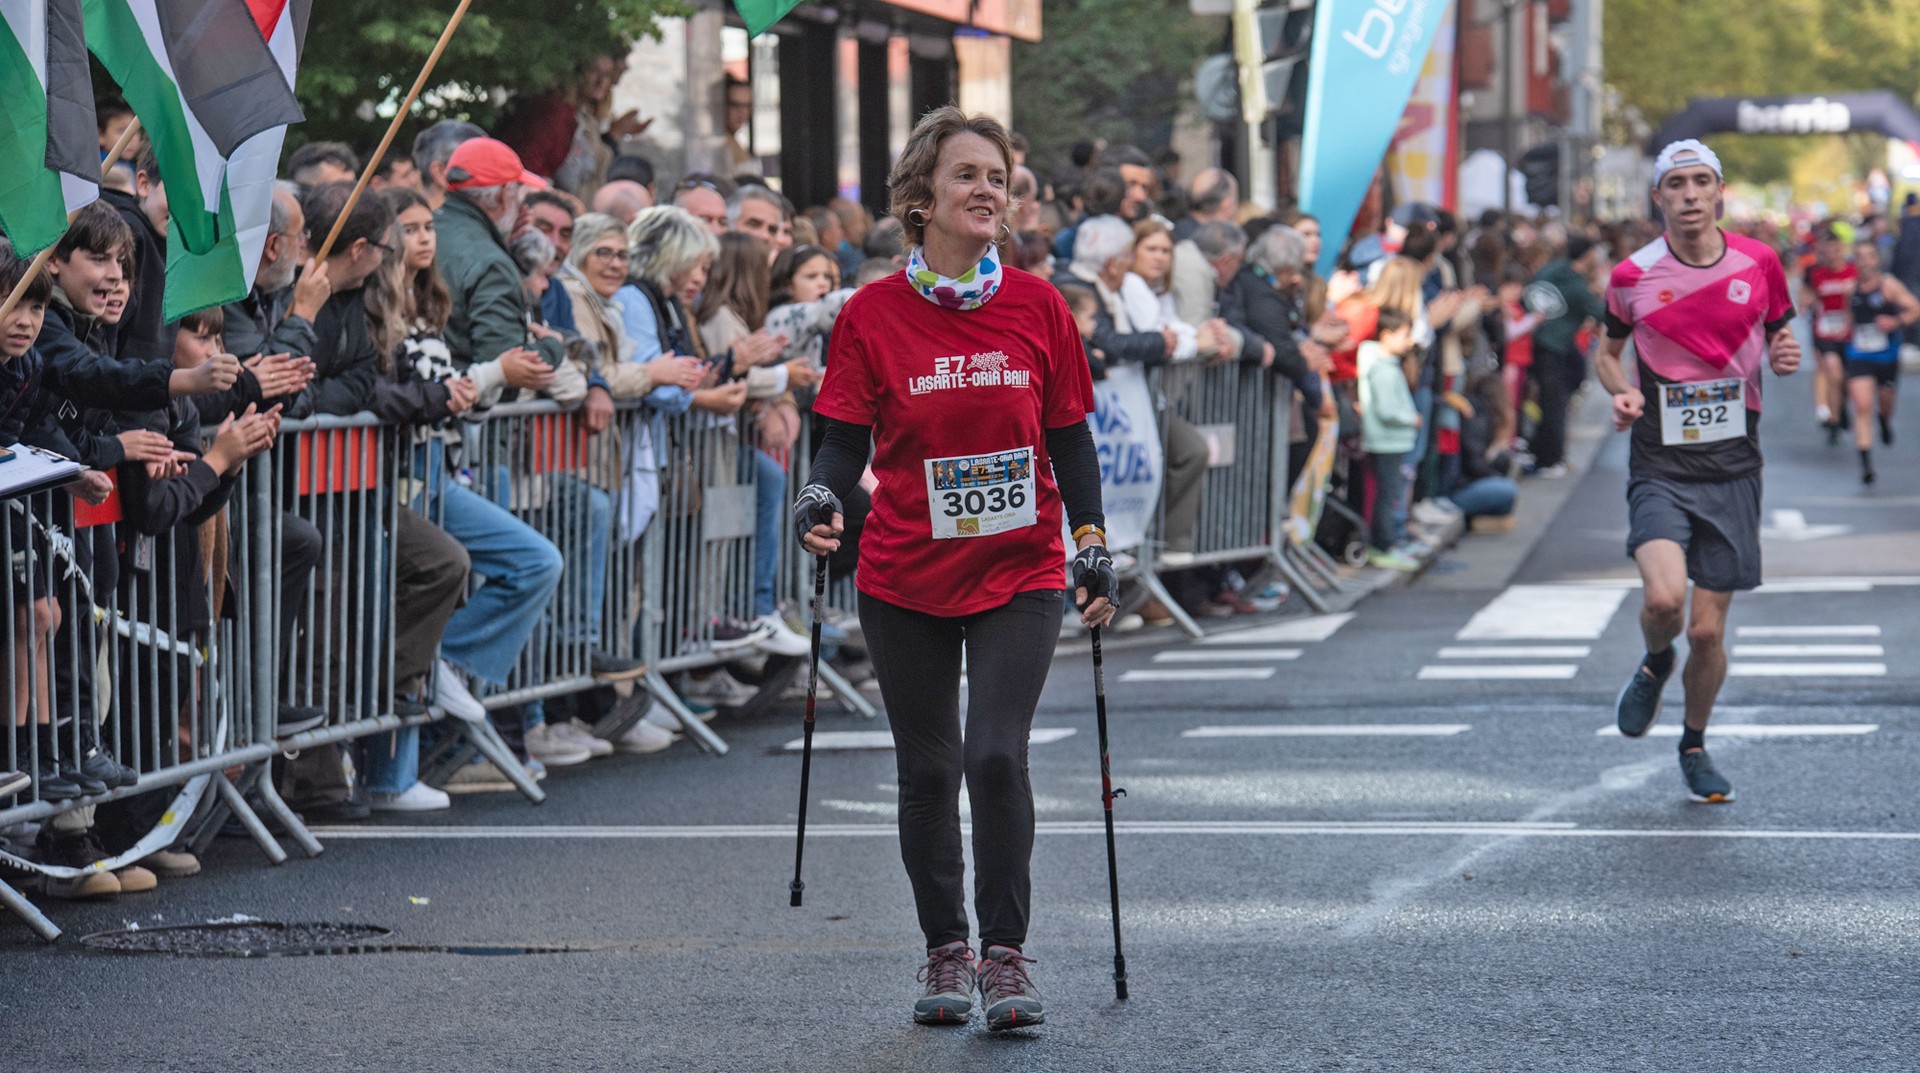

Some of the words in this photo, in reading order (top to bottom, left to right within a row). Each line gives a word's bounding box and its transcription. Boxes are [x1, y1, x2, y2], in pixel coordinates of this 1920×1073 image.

[935, 355, 965, 375] 27
[1681, 405, 1729, 427] 292
[942, 484, 1025, 516] 3036
